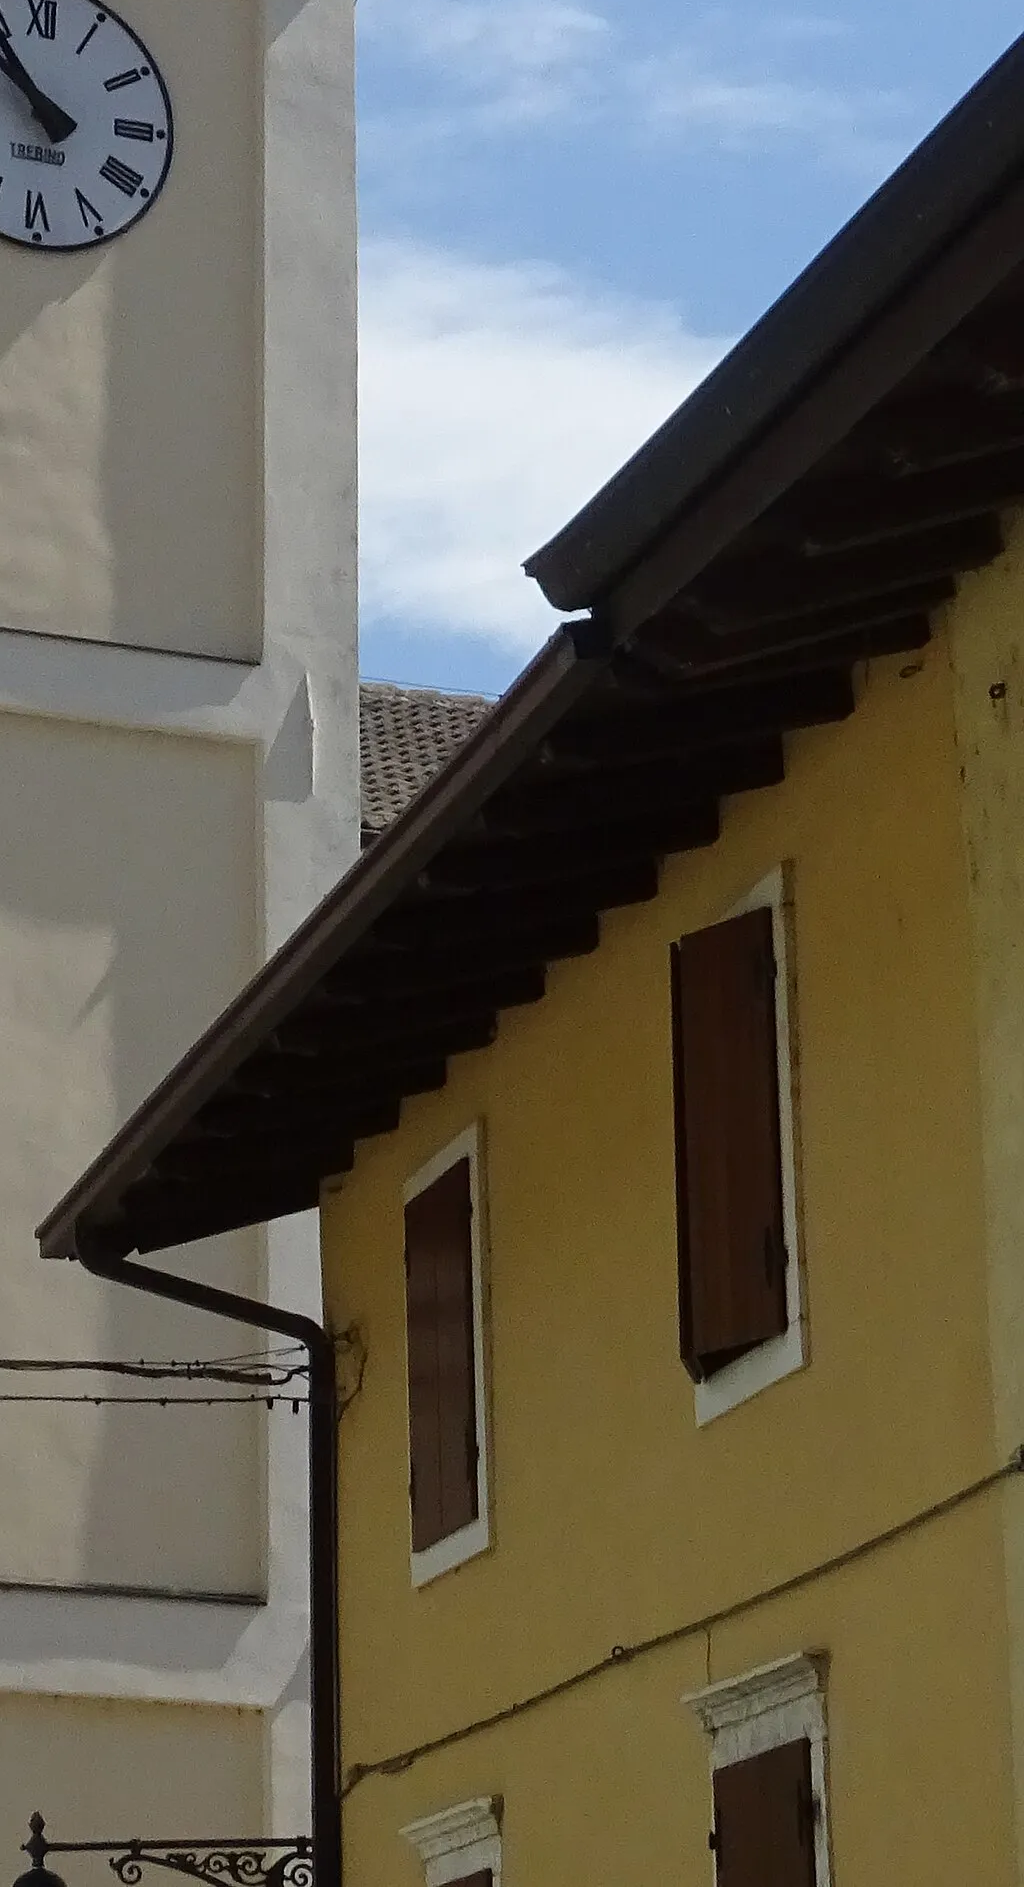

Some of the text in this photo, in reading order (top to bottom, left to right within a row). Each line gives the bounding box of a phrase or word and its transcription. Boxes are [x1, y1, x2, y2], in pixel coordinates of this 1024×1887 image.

[76, 22, 98, 55] I
[103, 68, 141, 92] II
[114, 118, 154, 142] III
[25, 189, 50, 232] VI
[74, 187, 103, 227] V
